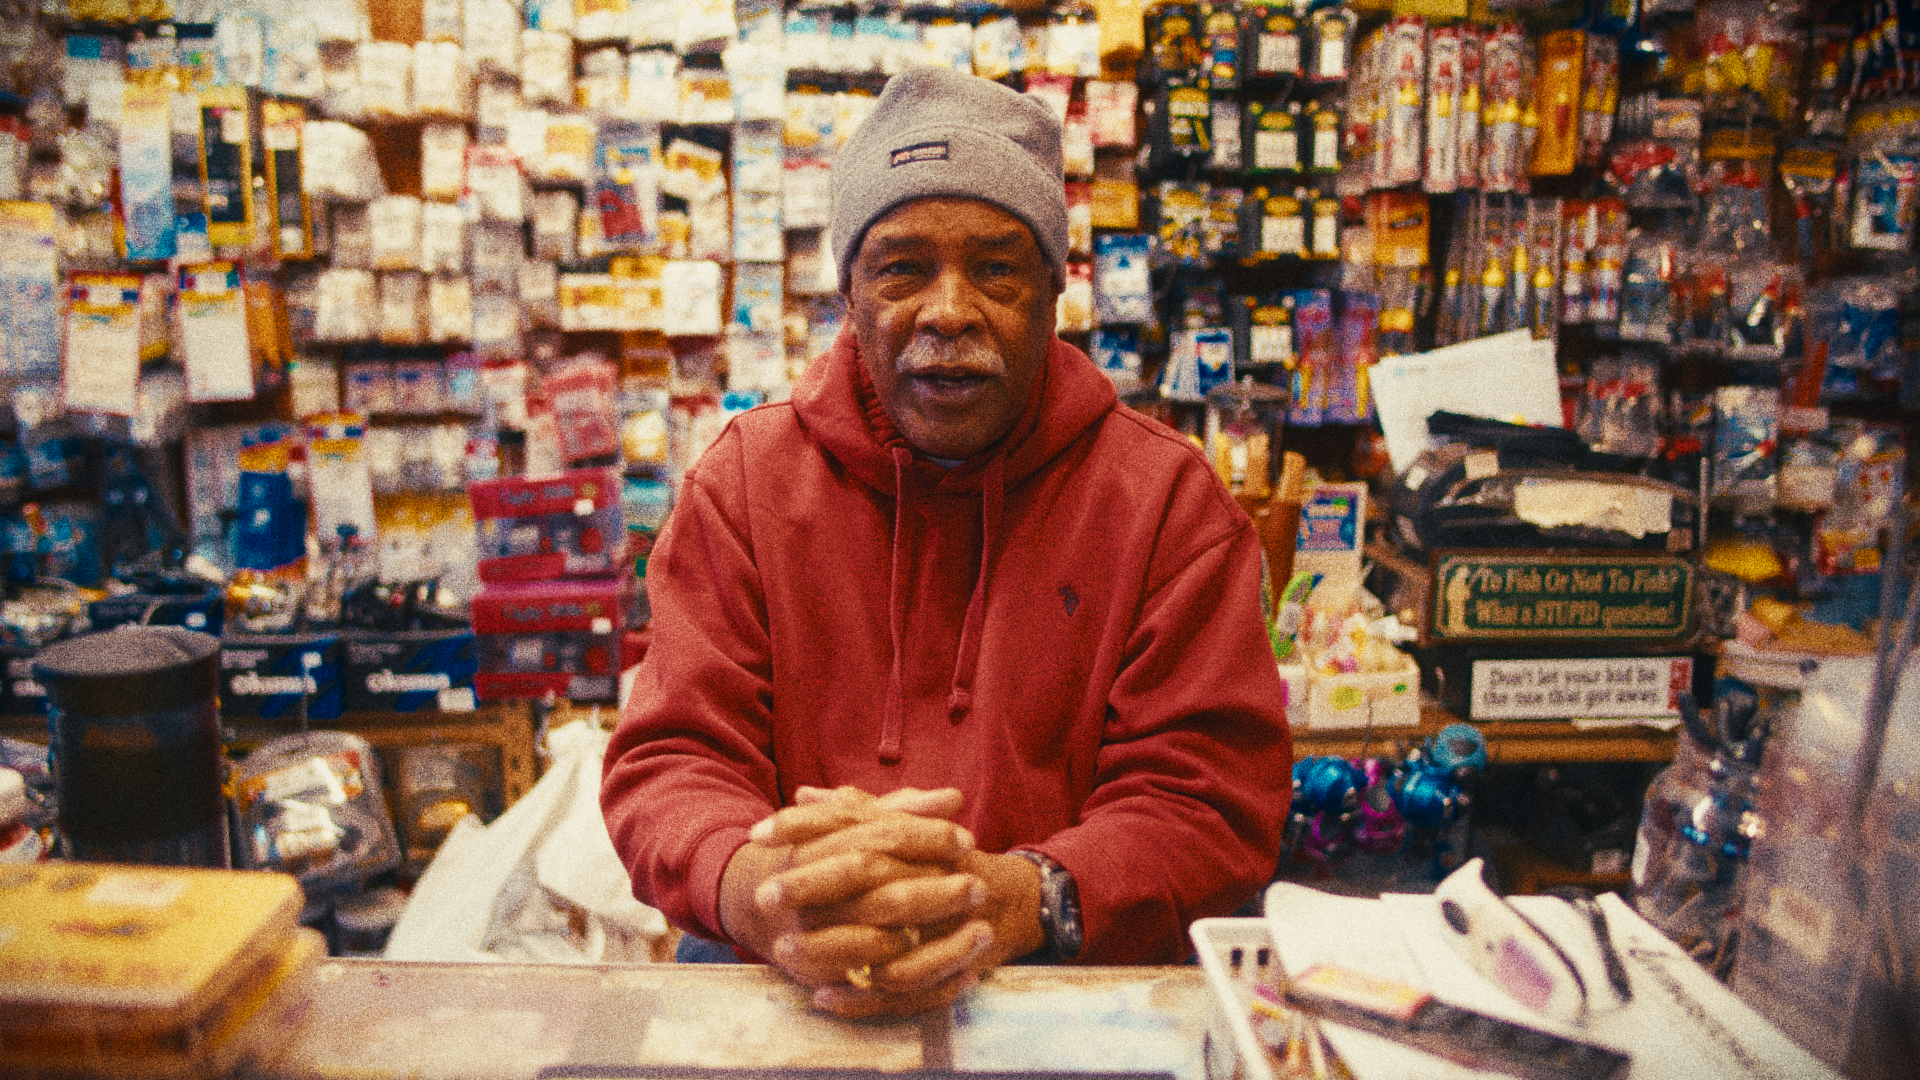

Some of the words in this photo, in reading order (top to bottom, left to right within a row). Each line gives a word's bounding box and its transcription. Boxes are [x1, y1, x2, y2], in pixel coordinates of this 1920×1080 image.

[1479, 568, 1502, 592] To
[1506, 568, 1541, 592] Fish
[1545, 568, 1568, 592] Or
[1572, 569, 1604, 592] Not
[1607, 568, 1631, 592] To
[1633, 568, 1679, 593] Fish?
[1476, 600, 1519, 624] What
[1521, 607, 1533, 625] a
[1534, 600, 1599, 626] STUPID
[1602, 601, 1676, 629] question!
[1489, 667, 1532, 685] Don't
[1538, 667, 1558, 685] let
[1564, 671, 1601, 689] your
[1606, 666, 1632, 684] kid
[1483, 690, 1508, 705] the
[1515, 692, 1543, 705] one
[1549, 689, 1579, 704] that
[1584, 689, 1611, 709] got
